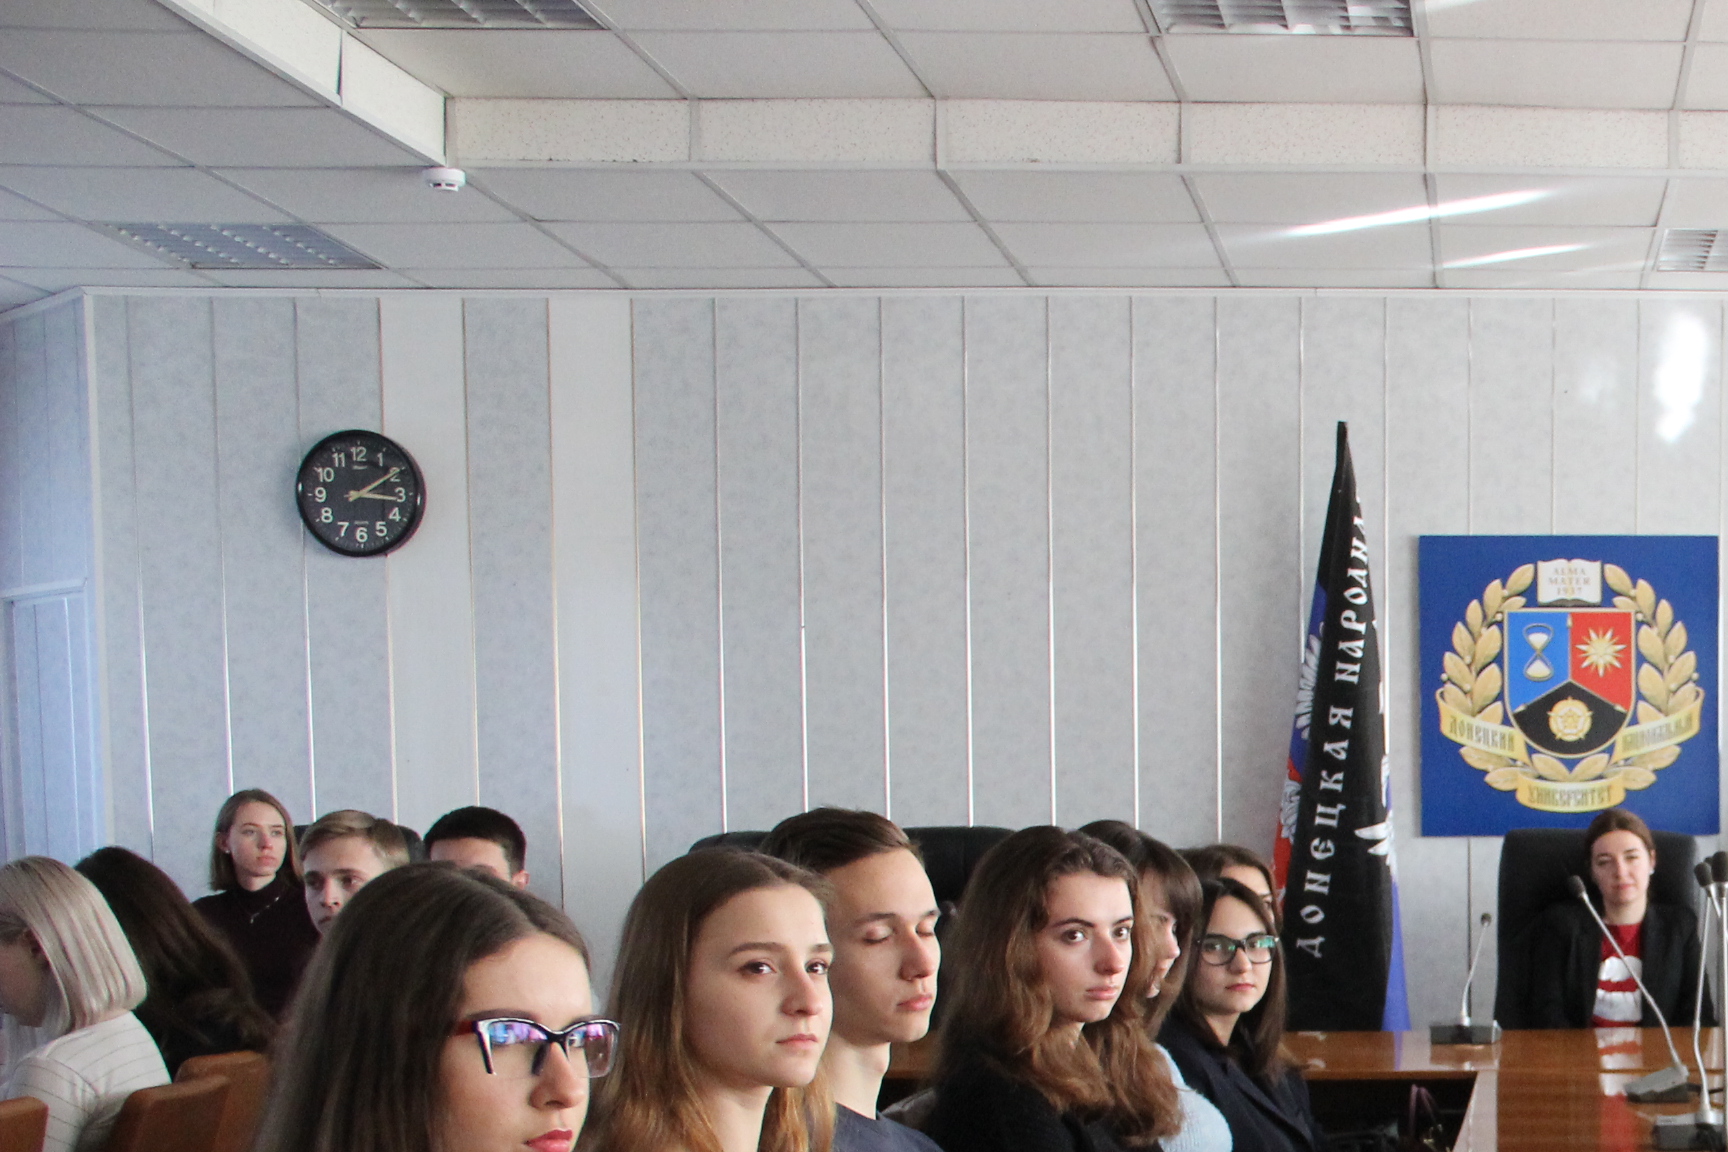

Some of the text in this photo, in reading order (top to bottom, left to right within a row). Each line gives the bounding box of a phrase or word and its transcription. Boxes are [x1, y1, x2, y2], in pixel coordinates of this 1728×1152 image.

[332, 453, 346, 467] 11
[351, 447, 367, 461] 12
[377, 453, 383, 467] 1
[317, 467, 334, 482] 10
[389, 467, 400, 482] 2
[314, 487, 326, 502] 9
[395, 487, 406, 502] 3
[321, 507, 333, 523] 8
[389, 507, 401, 522] 4
[337, 521, 349, 537] 7
[355, 527, 368, 542] 6
[375, 521, 387, 536] 5
